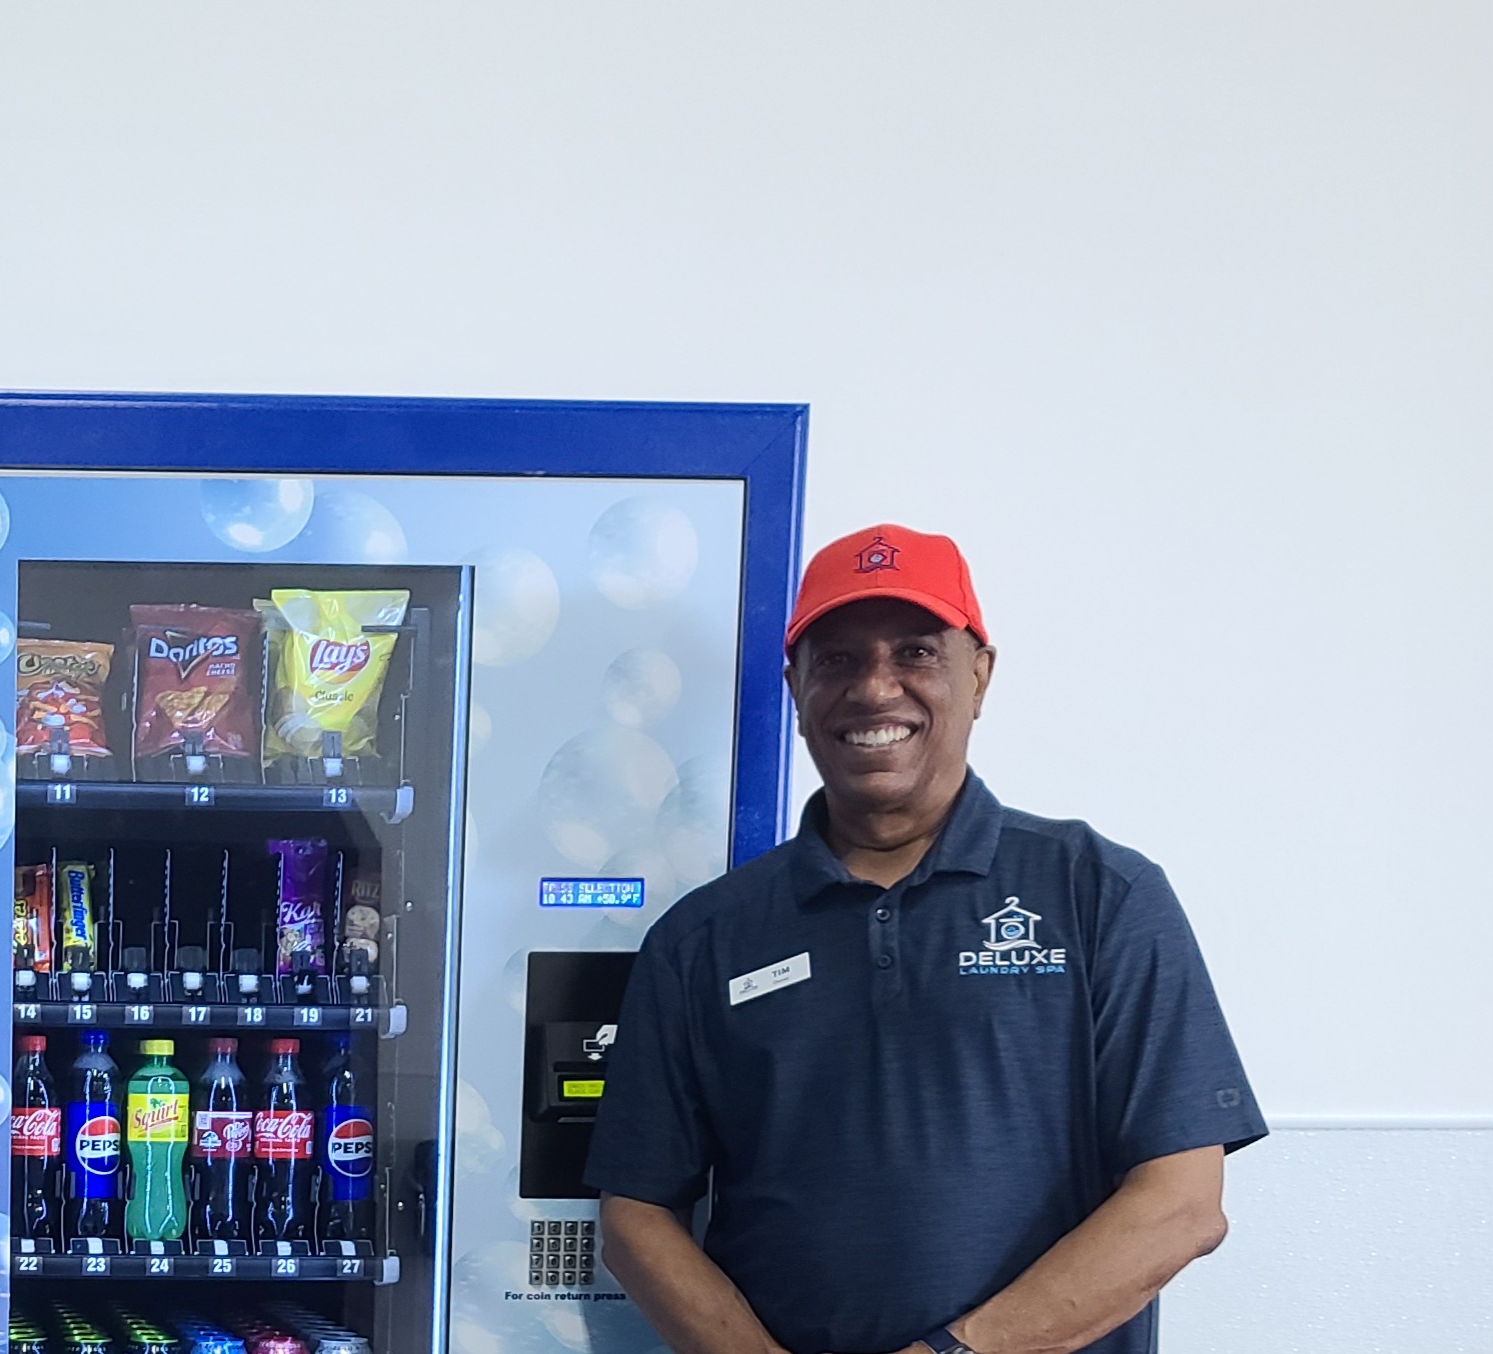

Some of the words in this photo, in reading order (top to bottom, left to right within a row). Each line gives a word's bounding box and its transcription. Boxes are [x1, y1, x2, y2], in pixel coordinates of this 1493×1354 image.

[149, 636, 239, 662] Doritos
[315, 690, 354, 702] Clasic
[54, 785, 70, 799] 11
[192, 787, 209, 801] 12
[329, 789, 346, 803] 13
[351, 880, 380, 898] RITZ
[68, 871, 87, 940] Butterfinger
[959, 948, 1066, 966] DELUXE
[771, 966, 790, 978] TIM
[959, 966, 1029, 975] LAUNDRY
[1035, 965, 1065, 974] SPA
[18, 1005, 36, 1018] 14
[73, 1006, 92, 1019] 15
[131, 1006, 149, 1020] 16
[188, 1007, 206, 1021] 17
[244, 1007, 262, 1021] 18
[300, 1008, 318, 1022] 19
[355, 1008, 372, 1021] 21
[134, 1099, 179, 1131] Squirt
[255, 1112, 312, 1138] Coca-Cola
[19, 1258, 37, 1271] 22
[87, 1258, 106, 1272] 23
[151, 1259, 169, 1272] 24
[213, 1260, 232, 1272] 25
[277, 1261, 295, 1273] 26
[343, 1261, 360, 1274] 27
[505, 1292, 523, 1300] For
[527, 1292, 551, 1300] coin
[555, 1292, 591, 1300] return
[594, 1293, 626, 1302] press
